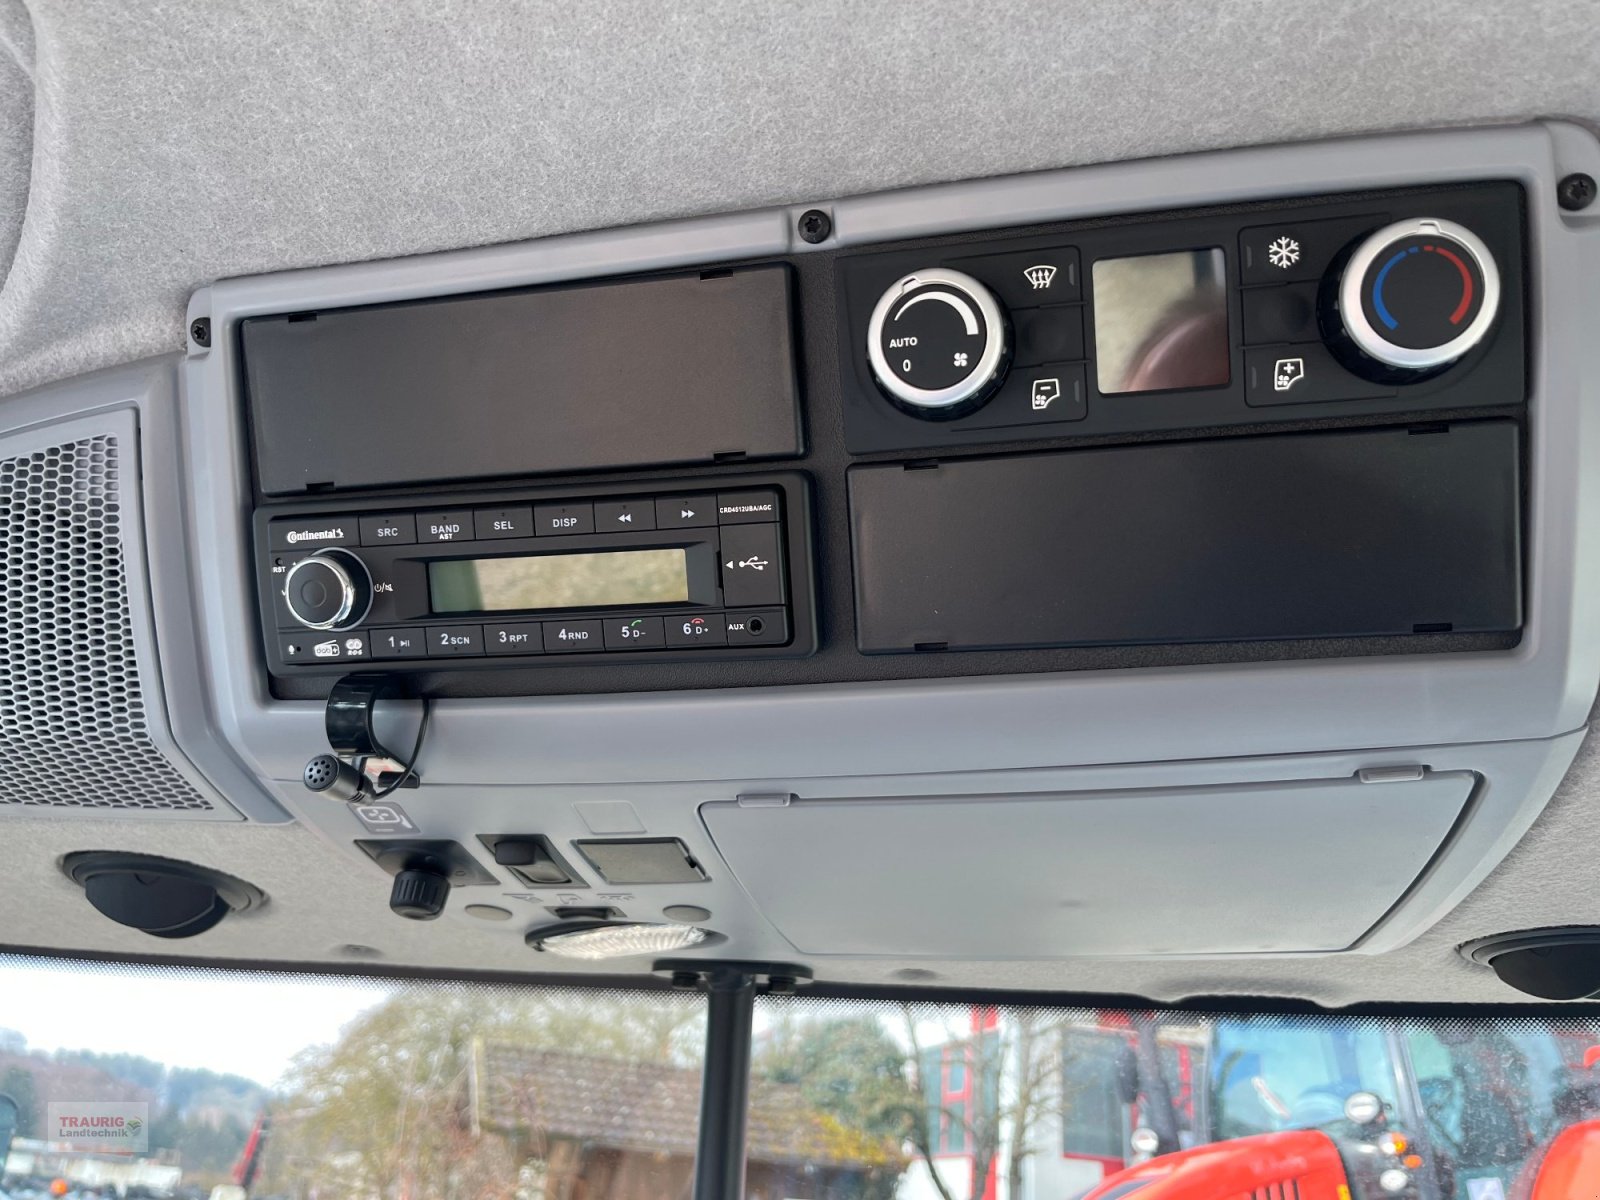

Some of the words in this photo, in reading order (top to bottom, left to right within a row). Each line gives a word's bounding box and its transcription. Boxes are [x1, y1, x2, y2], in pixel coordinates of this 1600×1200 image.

[889, 337, 917, 348] AUTO
[902, 359, 911, 372] 0
[719, 504, 772, 514] CRD4512UBA/AGC
[494, 521, 514, 530] SEL
[552, 518, 577, 528] DISP
[377, 528, 398, 537] SRC
[431, 525, 460, 534] BAND
[287, 529, 336, 543] Continental
[729, 623, 744, 631] AUX
[509, 634, 528, 643] RPT
[569, 631, 588, 639] RND
[388, 636, 395, 648] 1
[451, 636, 470, 644] SCN
